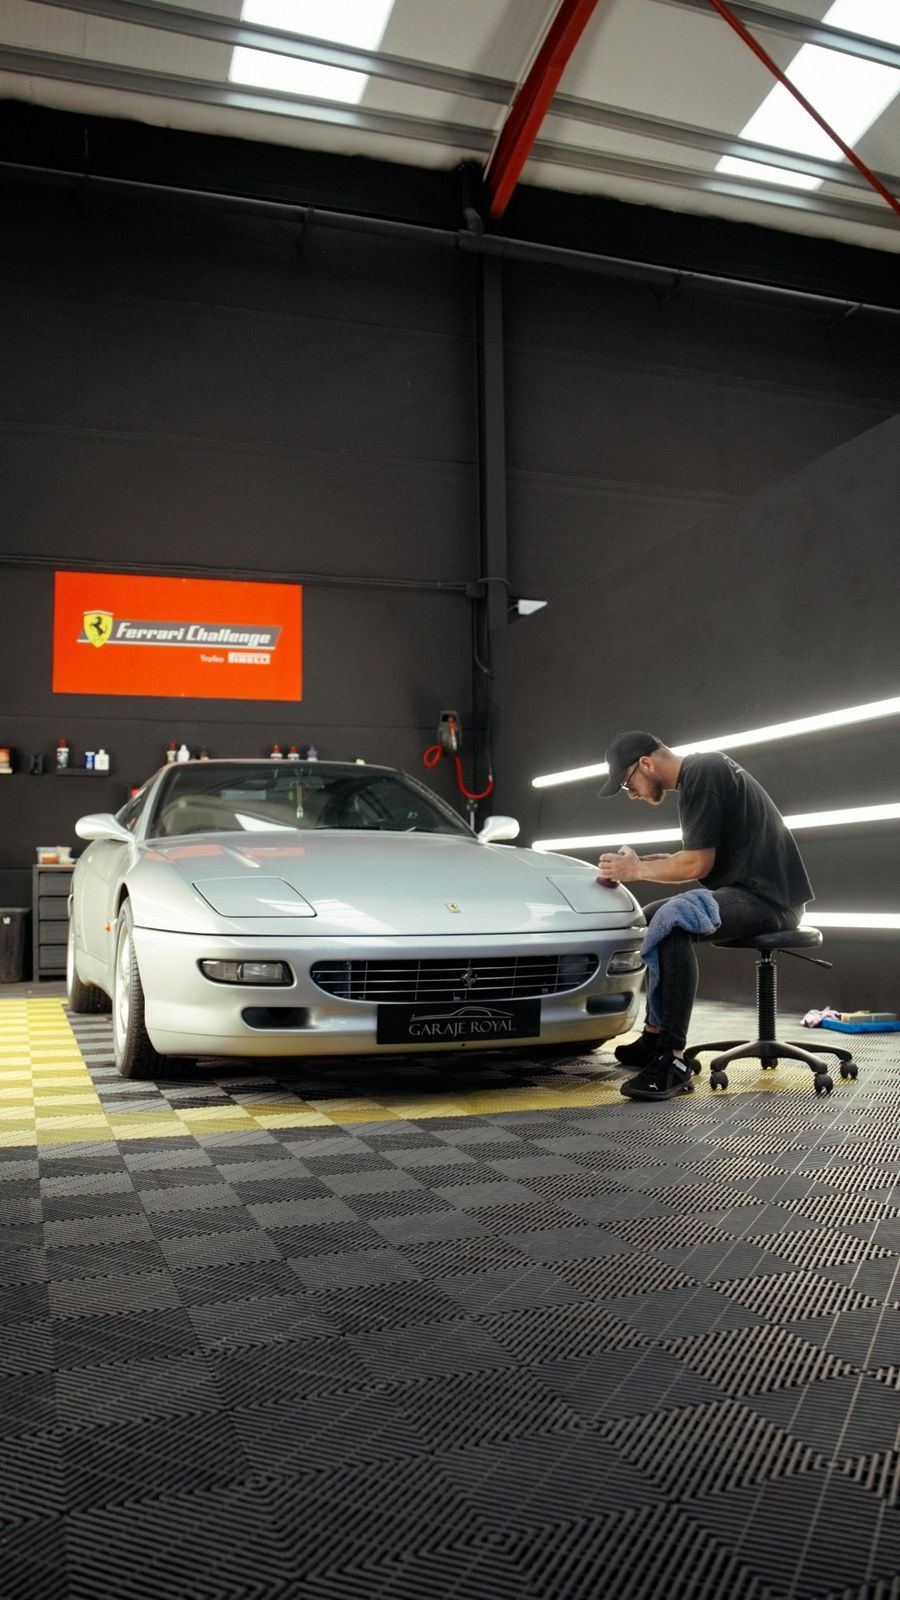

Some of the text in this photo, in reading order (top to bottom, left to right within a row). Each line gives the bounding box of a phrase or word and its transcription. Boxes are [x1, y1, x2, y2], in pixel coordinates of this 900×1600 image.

[116, 622, 271, 646] Ferrari Challenge
[408, 1019, 516, 1037] GARAJE ROYAL
